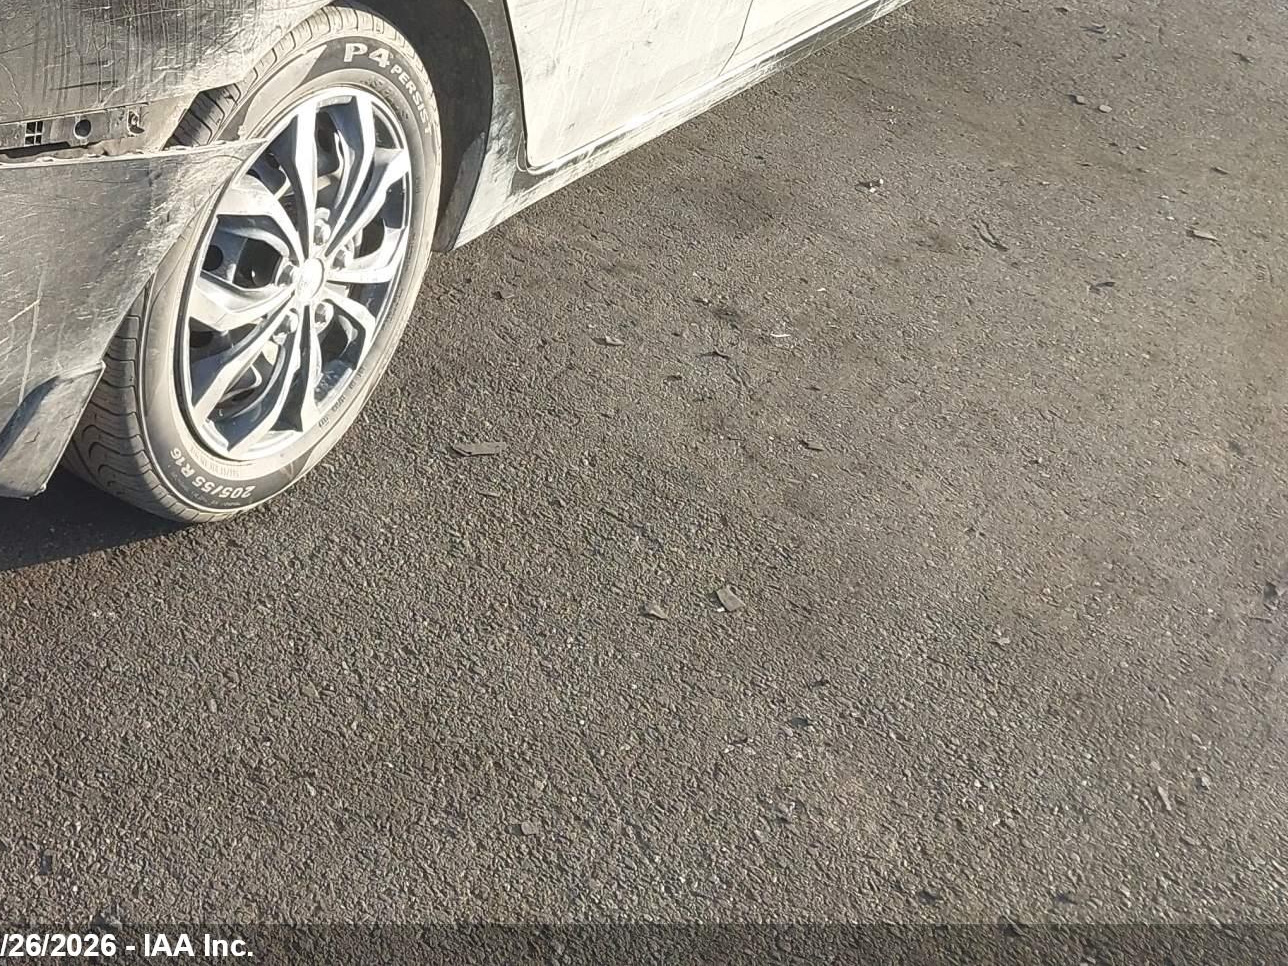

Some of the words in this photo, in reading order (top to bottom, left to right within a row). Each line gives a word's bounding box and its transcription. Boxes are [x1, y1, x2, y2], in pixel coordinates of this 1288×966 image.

[343, 42, 391, 68] P4
[390, 63, 433, 136] PERSIST
[170, 447, 195, 478] R16
[191, 475, 256, 499] 205/55
